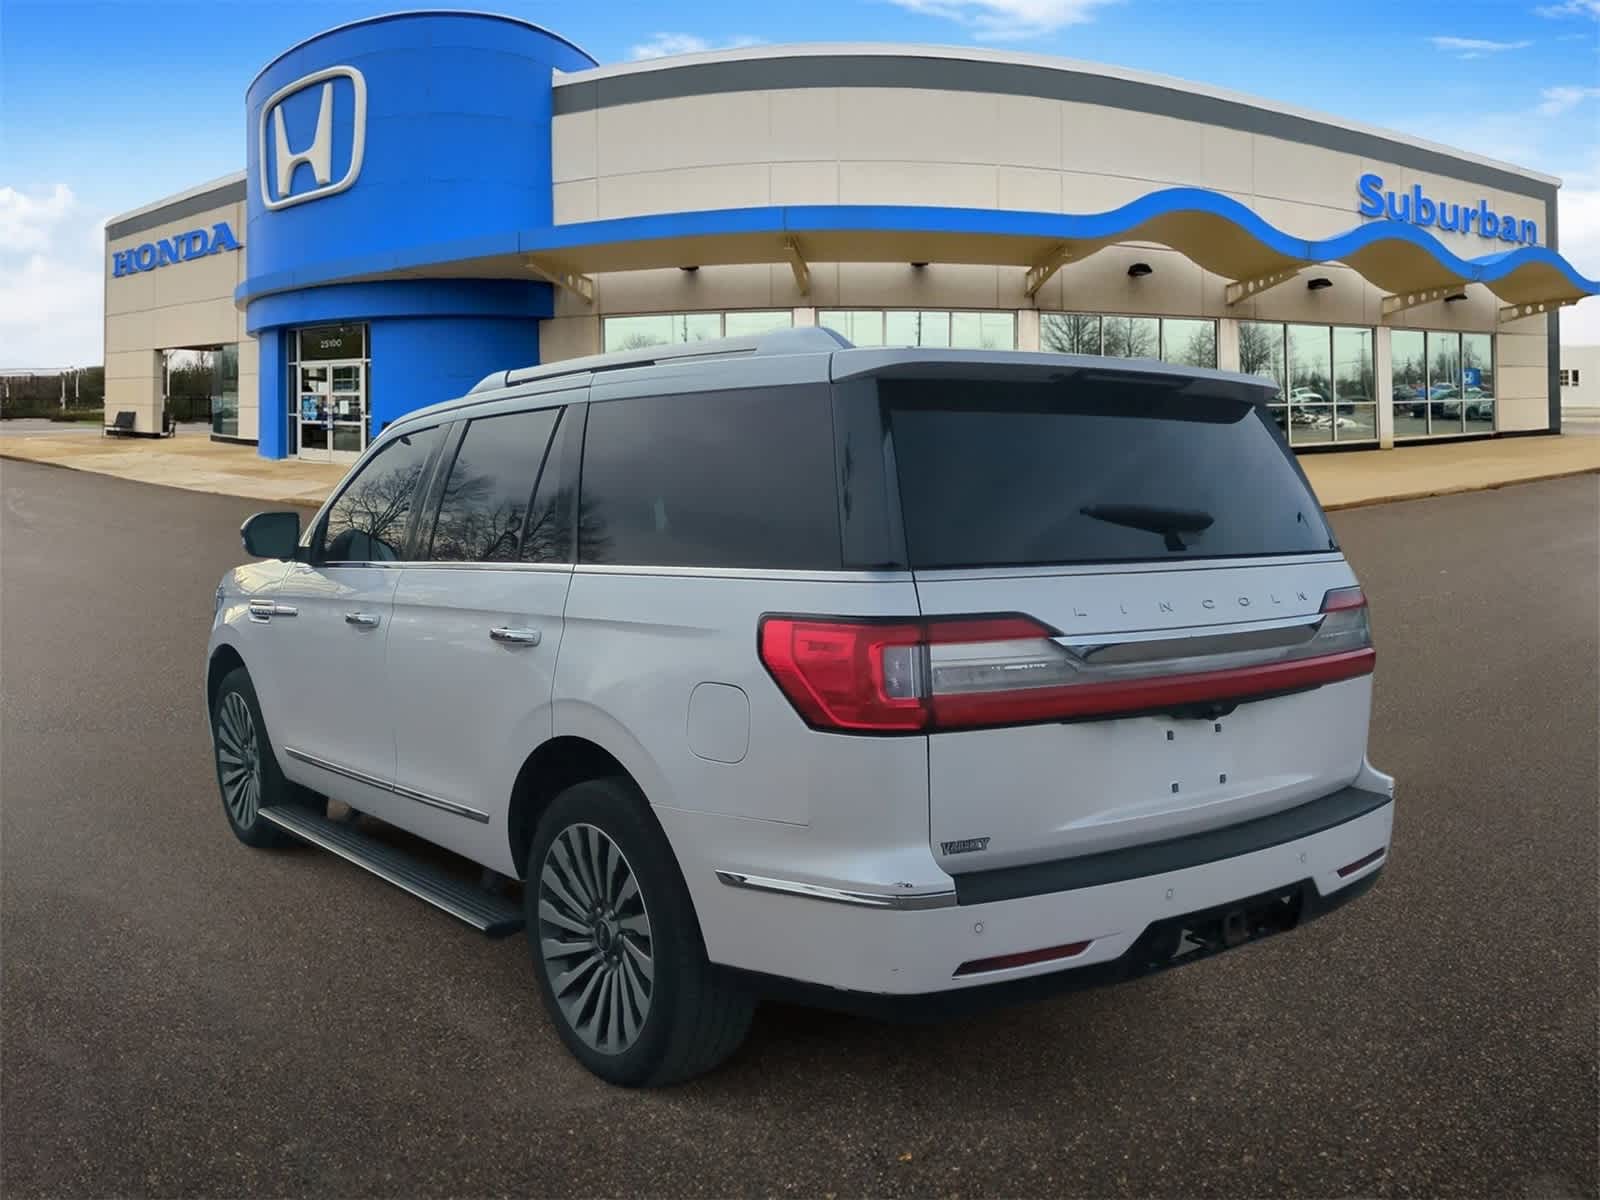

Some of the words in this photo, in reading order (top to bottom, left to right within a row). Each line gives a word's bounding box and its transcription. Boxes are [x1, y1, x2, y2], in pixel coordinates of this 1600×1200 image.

[1358, 173, 1537, 245] Suburban
[112, 221, 241, 278] HONDA
[1073, 591, 1308, 617] LINCOLN
